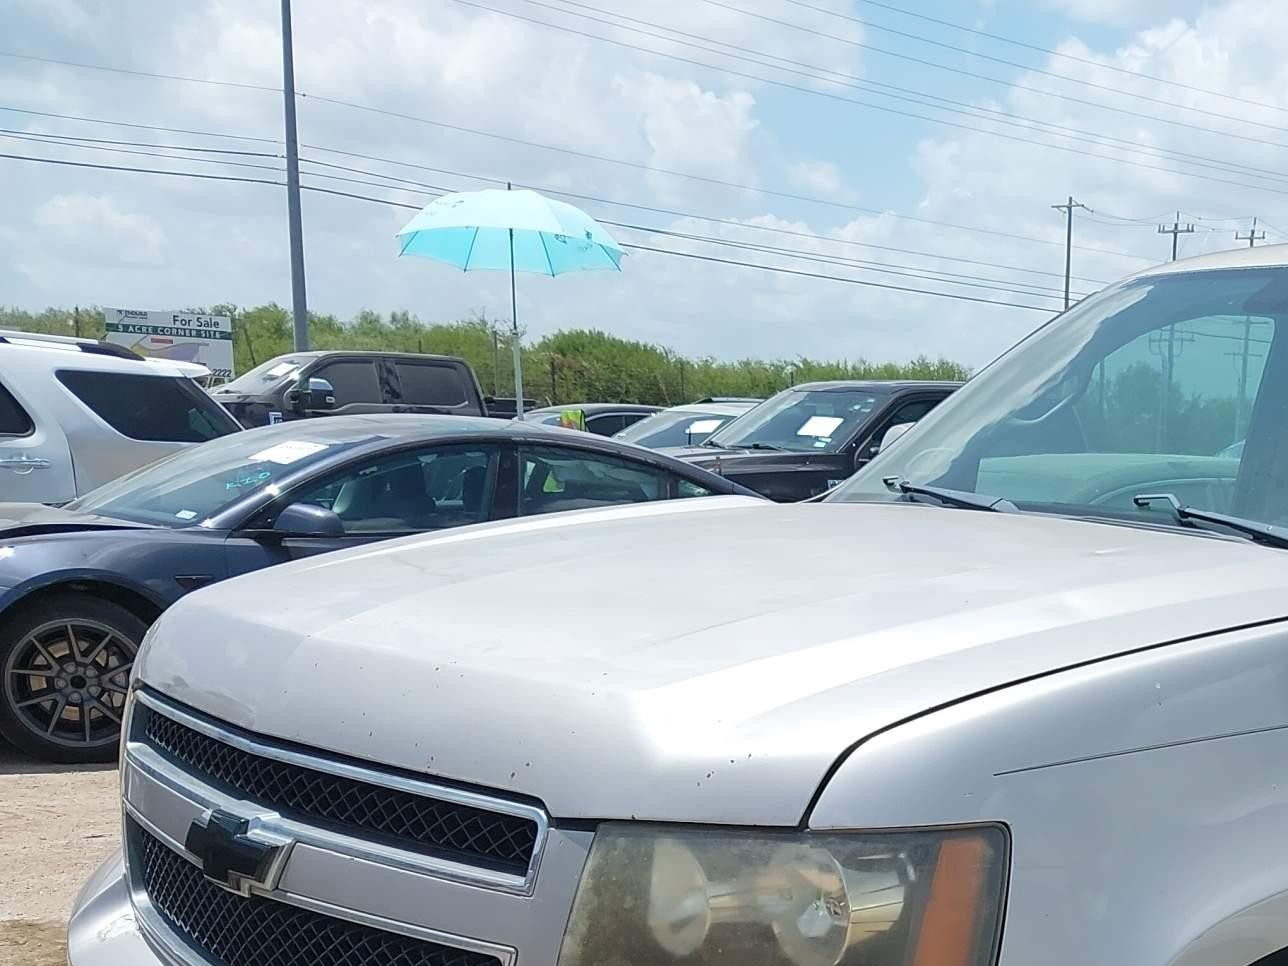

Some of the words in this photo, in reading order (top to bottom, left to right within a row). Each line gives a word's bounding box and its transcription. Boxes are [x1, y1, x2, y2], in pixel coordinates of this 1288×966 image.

[172, 314, 192, 327] For
[196, 316, 220, 329] Sale
[128, 325, 153, 334] ACRE
[157, 328, 197, 337] CORNER
[200, 330, 220, 339] SITE
